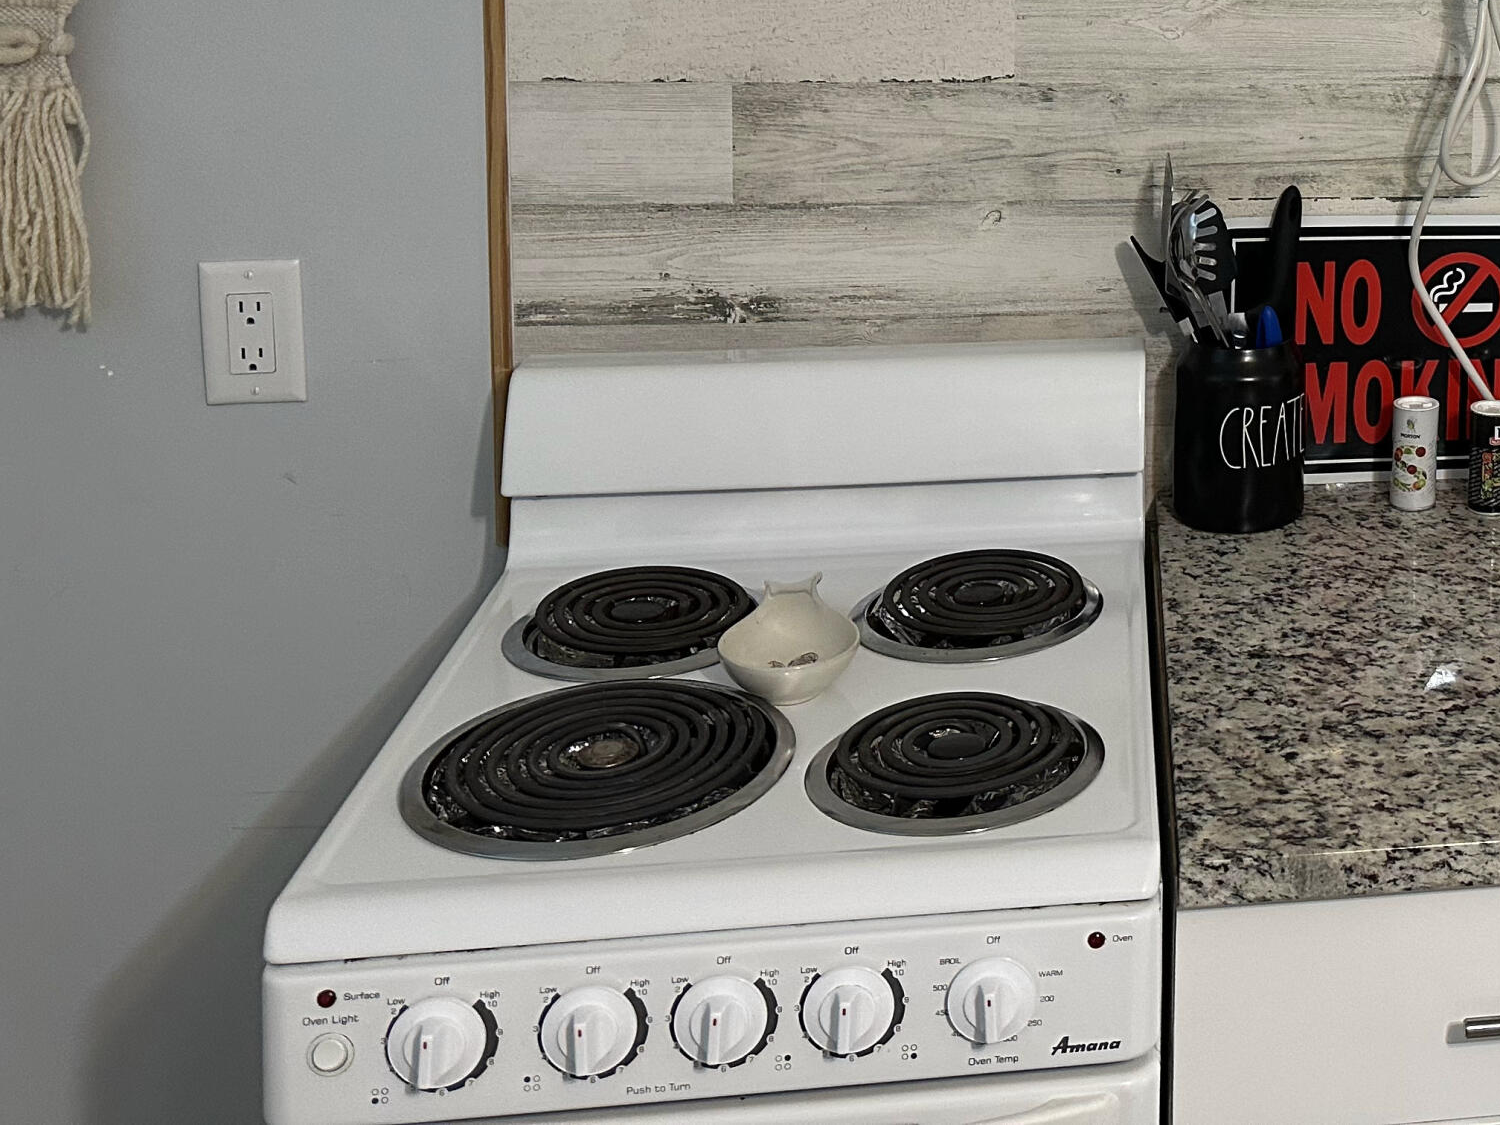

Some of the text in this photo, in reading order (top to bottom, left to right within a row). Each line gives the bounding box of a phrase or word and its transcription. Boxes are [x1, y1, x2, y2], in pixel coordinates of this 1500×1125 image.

[1295, 259, 1382, 345] NO
[986, 936, 1001, 945] Off
[844, 946, 859, 955] Off
[717, 956, 731, 965] Off
[887, 959, 907, 968] High
[586, 966, 601, 974] Off
[760, 969, 780, 977] High
[1038, 970, 1063, 978] WARM
[435, 977, 450, 986] Off
[630, 979, 650, 988] High
[932, 984, 948, 992] 500
[344, 992, 380, 1001] Surface
[480, 991, 500, 999] High
[1040, 995, 1055, 1003] 200
[387, 998, 405, 1006] Low
[303, 1014, 359, 1026] Oven Light
[1027, 1019, 1043, 1027] 250
[1051, 1036, 1121, 1056] Amana
[968, 1055, 1019, 1066] Oven Temp
[626, 1083, 691, 1095] Push to Turn
